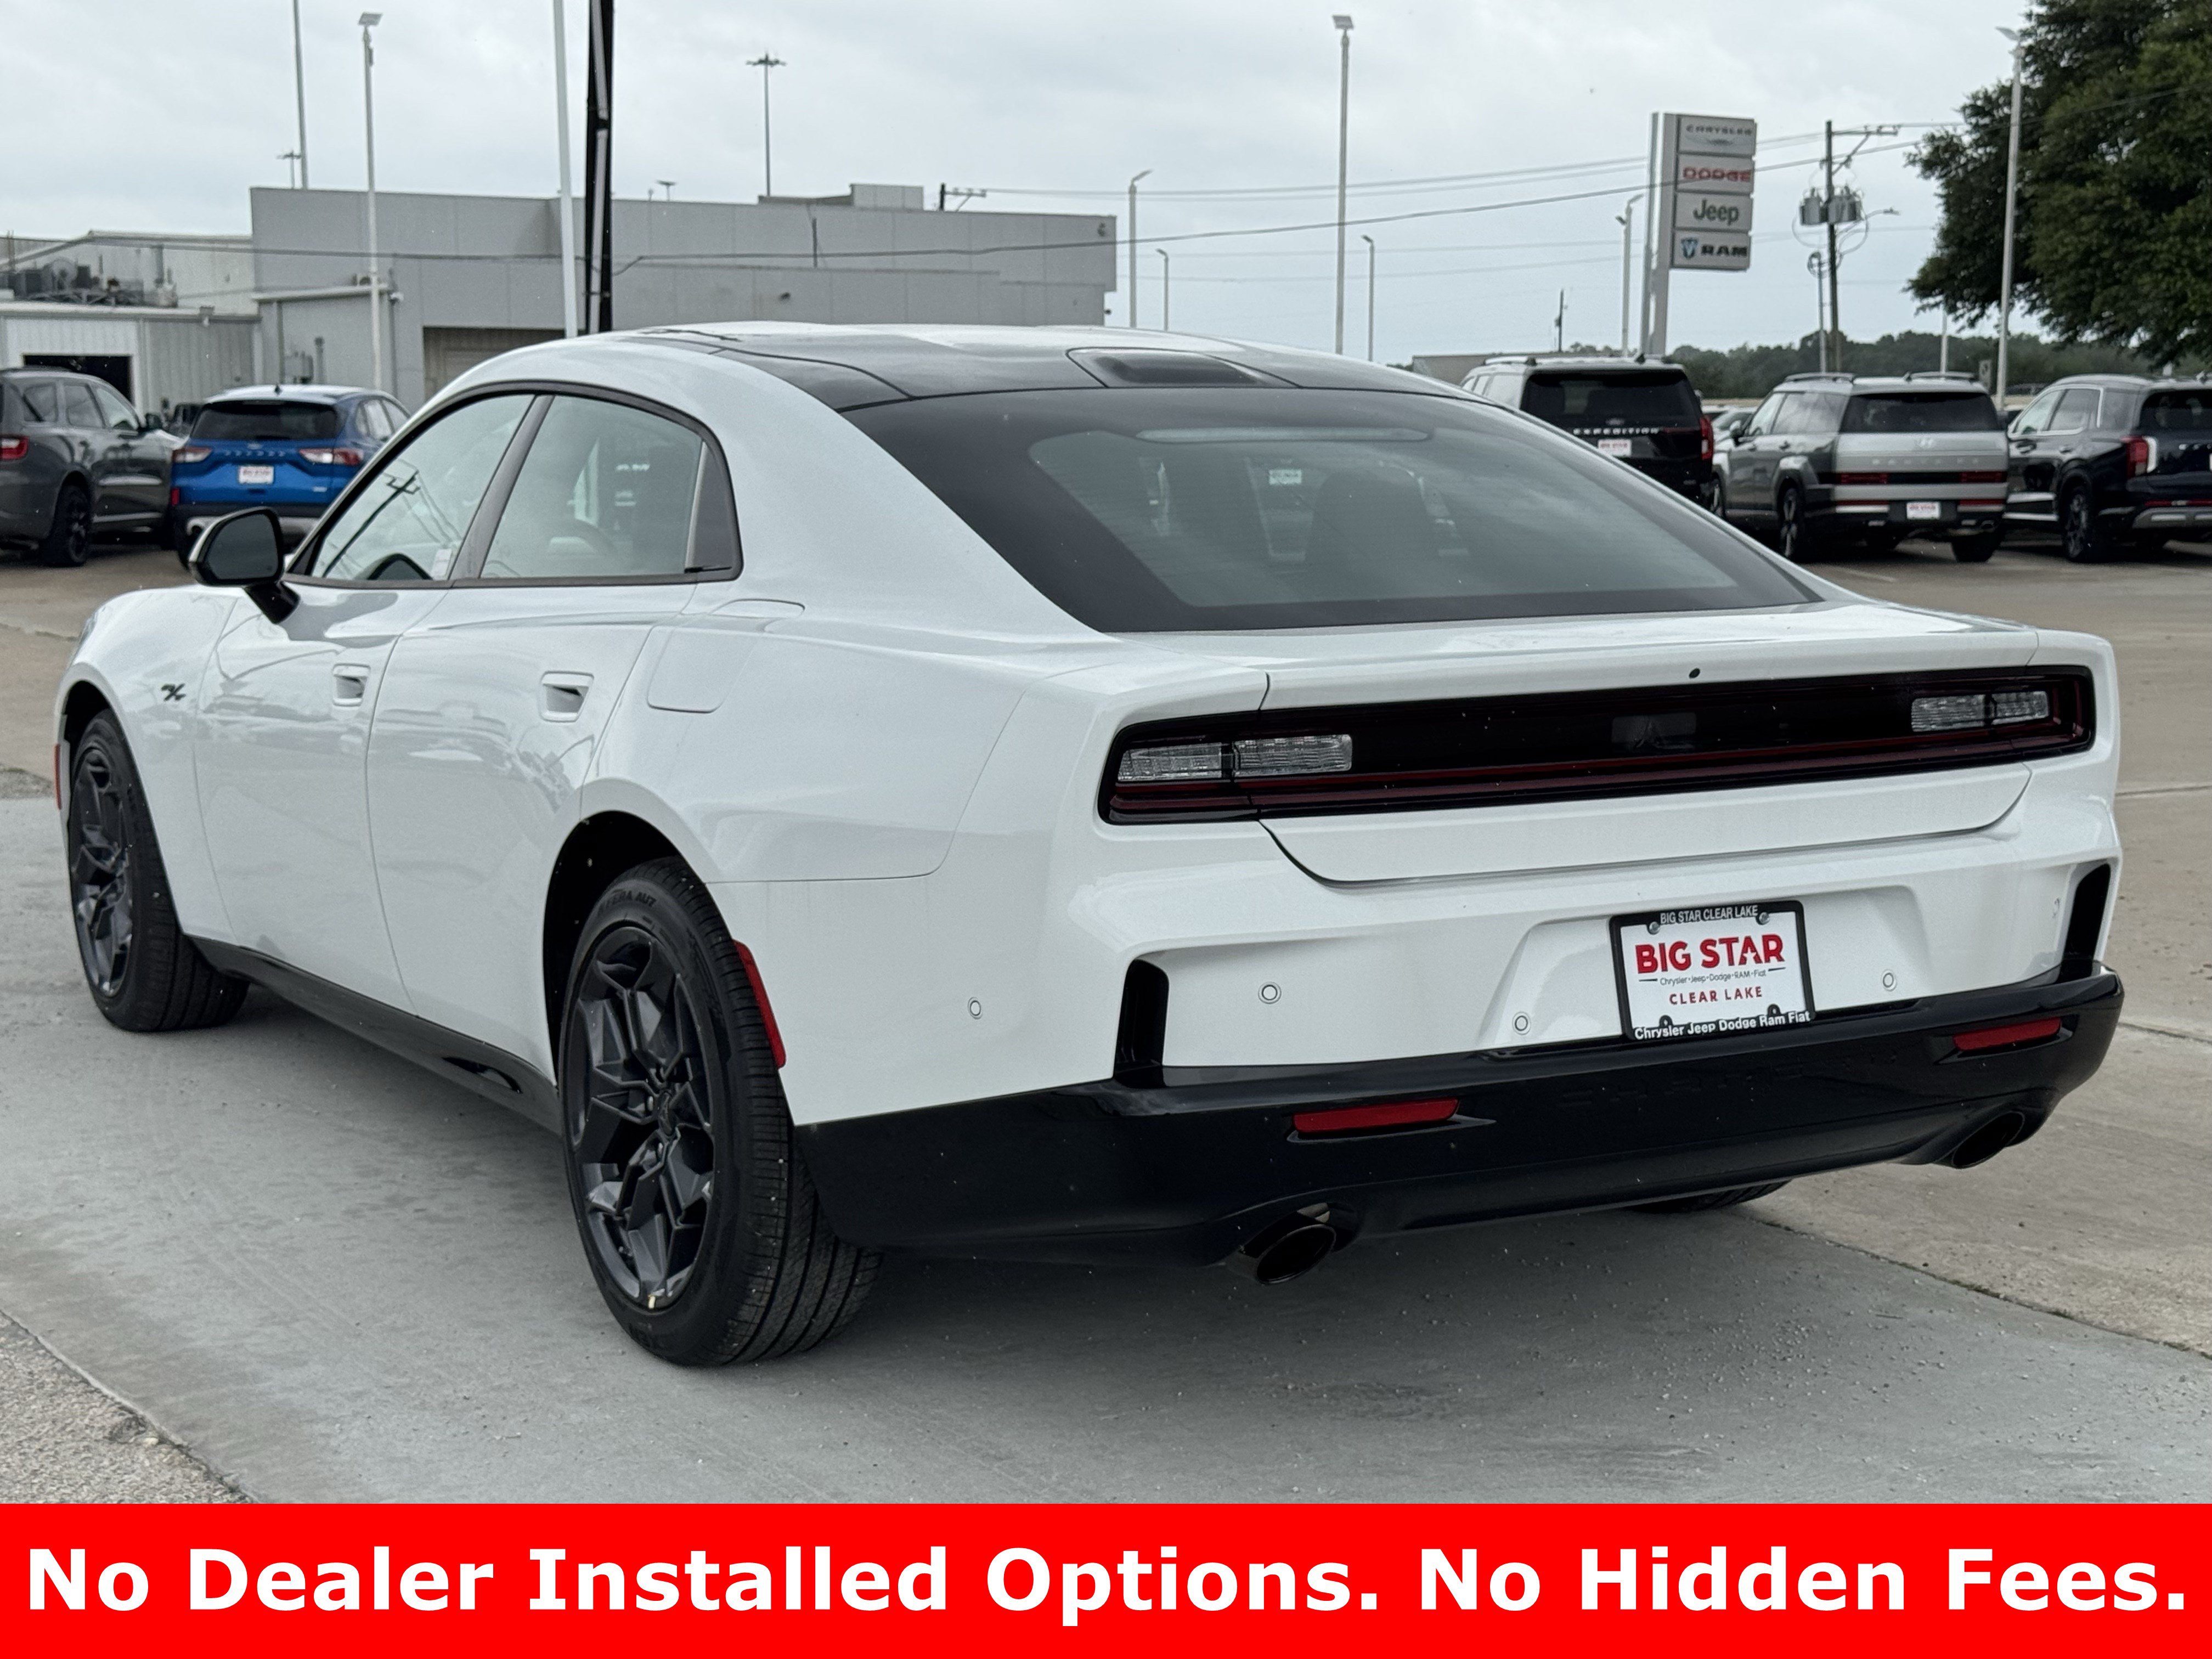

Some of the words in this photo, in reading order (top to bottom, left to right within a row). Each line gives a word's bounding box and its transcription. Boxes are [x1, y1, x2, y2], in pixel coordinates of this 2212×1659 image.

[1683, 167, 1751, 182] DODGE
[1693, 200, 1739, 226] Jeep
[1701, 244, 1748, 256] RAM
[1660, 912, 1676, 924] BIG
[1678, 910, 1701, 922] STAR
[1703, 907, 1733, 920] CLEAR
[1735, 905, 1758, 917] LAKE
[1635, 940, 1692, 974] BIG
[1700, 934, 1785, 968] STAR
[1669, 990, 1718, 1005] CLEAR
[1724, 986, 1763, 1000] LAKE
[1634, 1025, 1685, 1040] Chrysler
[1688, 1023, 1716, 1035] Jeep
[1718, 1017, 1756, 1032] Dodge
[1759, 1014, 1786, 1027] Ram
[1788, 1010, 1810, 1023] Fiat
